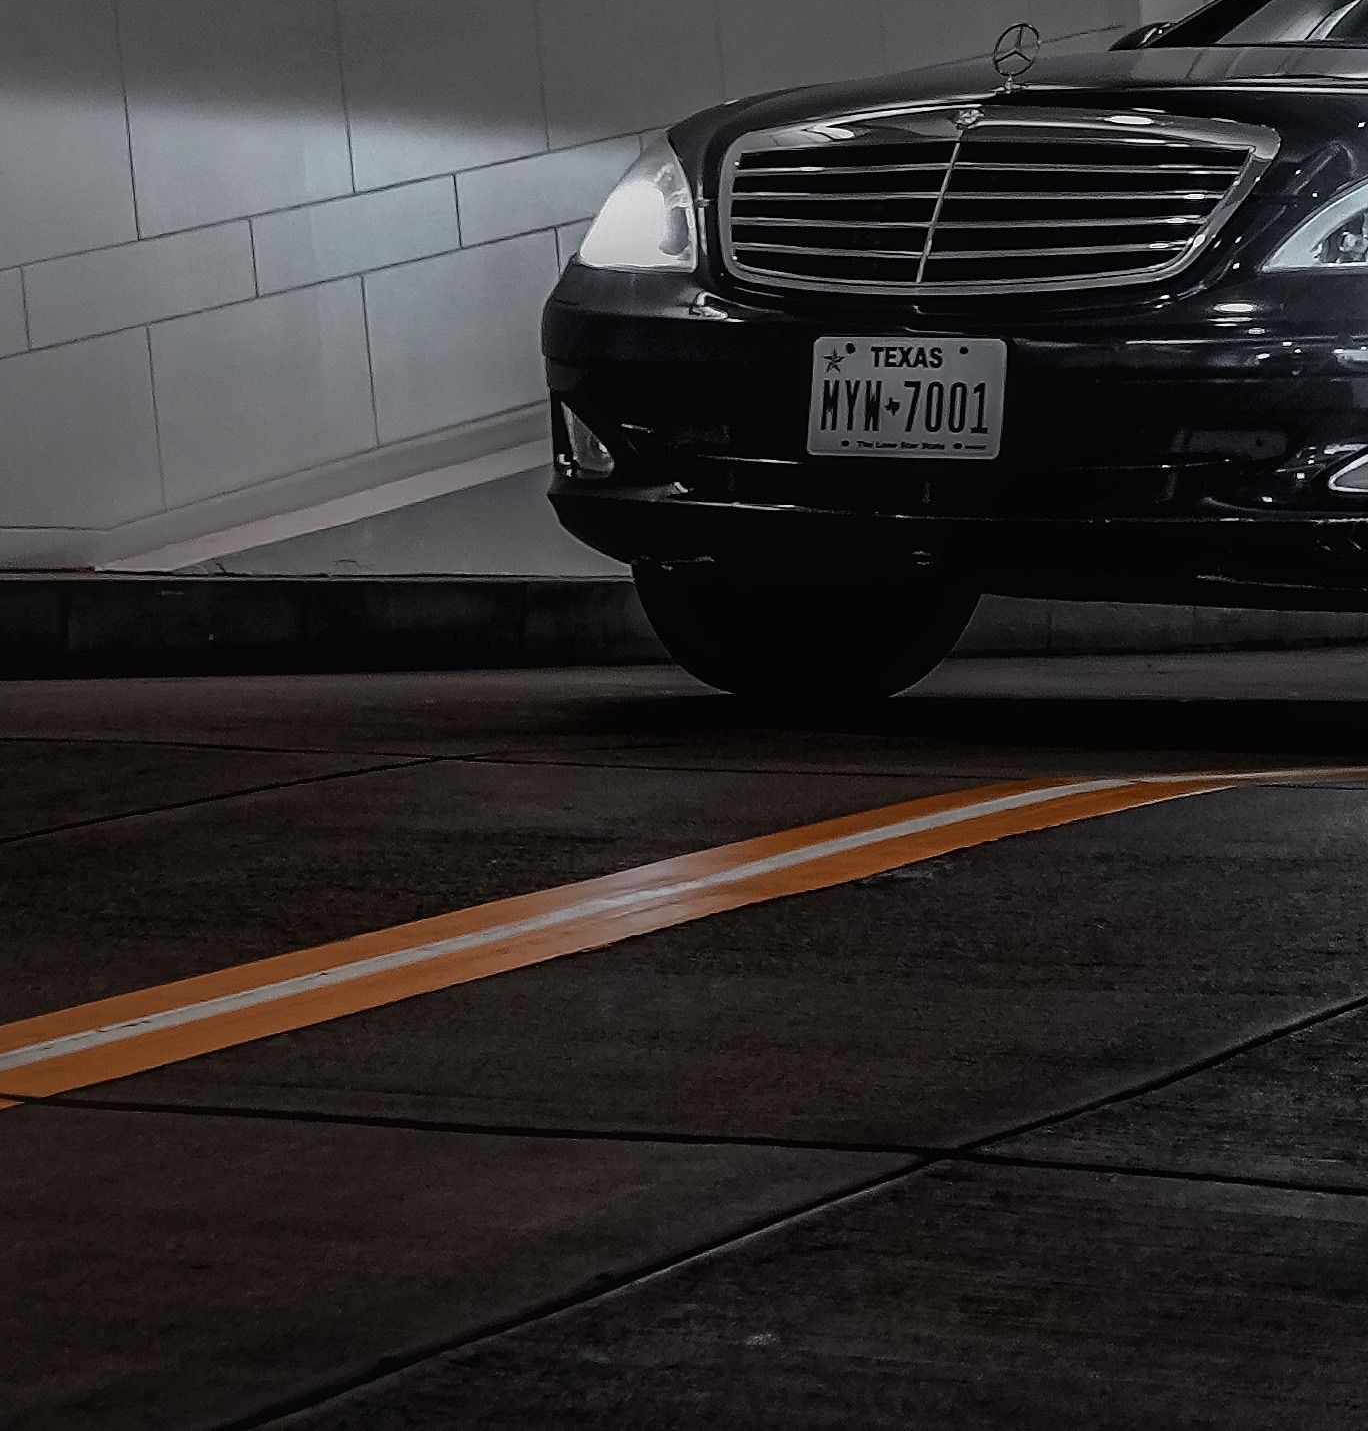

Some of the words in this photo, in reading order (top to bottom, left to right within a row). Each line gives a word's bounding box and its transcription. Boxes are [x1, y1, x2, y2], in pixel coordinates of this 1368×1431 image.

[871, 346, 943, 369] TEXAS
[820, 379, 882, 432] MYW
[904, 380, 988, 434] 7001
